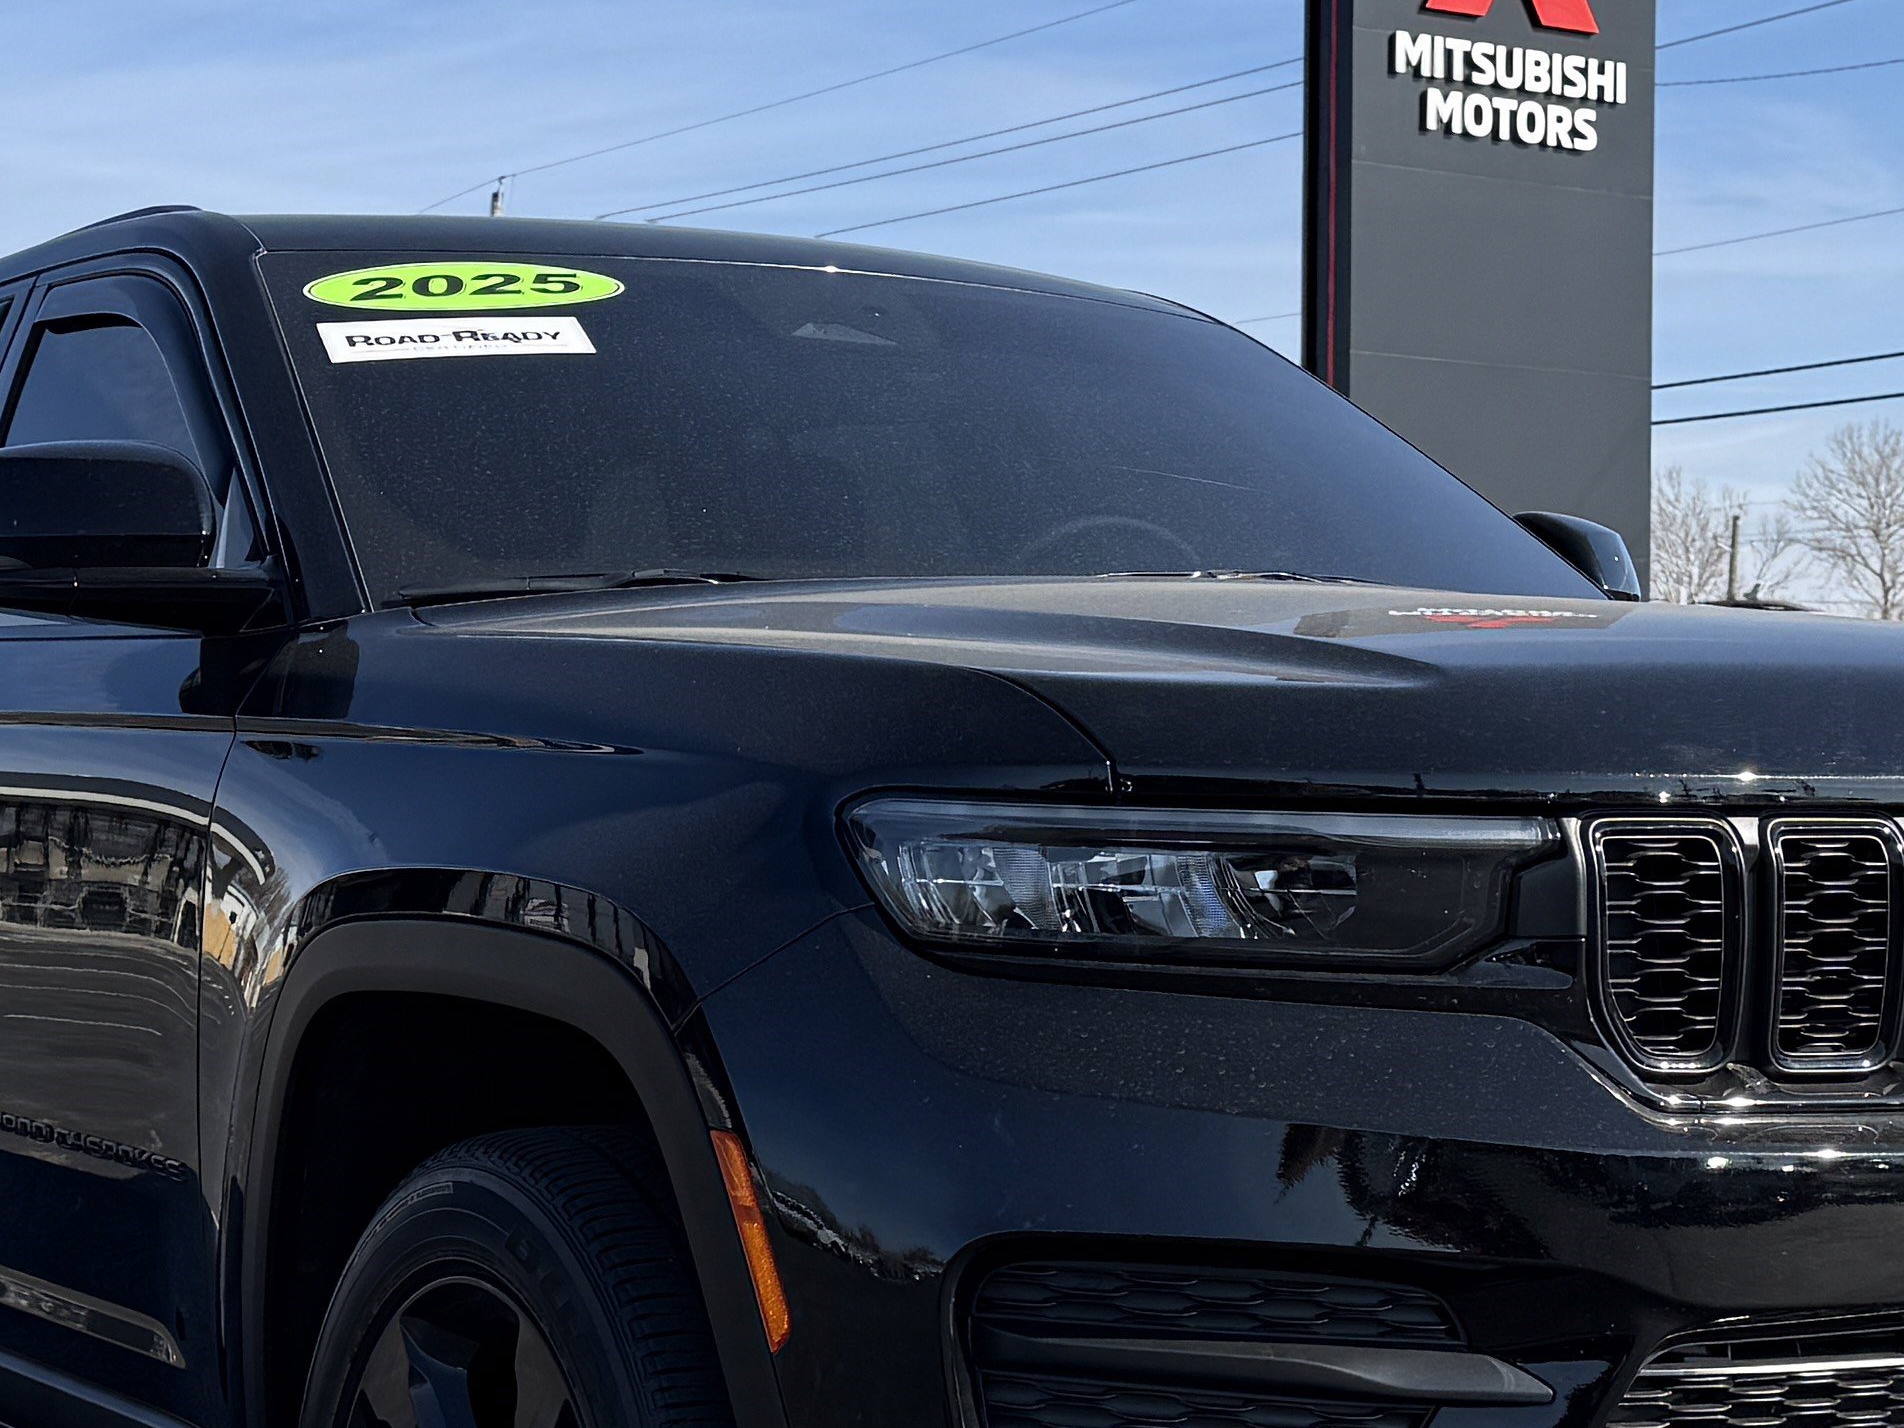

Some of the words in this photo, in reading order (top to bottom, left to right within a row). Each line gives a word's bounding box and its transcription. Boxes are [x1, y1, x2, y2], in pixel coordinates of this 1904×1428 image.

[1395, 30, 1627, 104] MITSUBISHI
[1426, 87, 1598, 151] MOTORS
[349, 273, 583, 302] 2025
